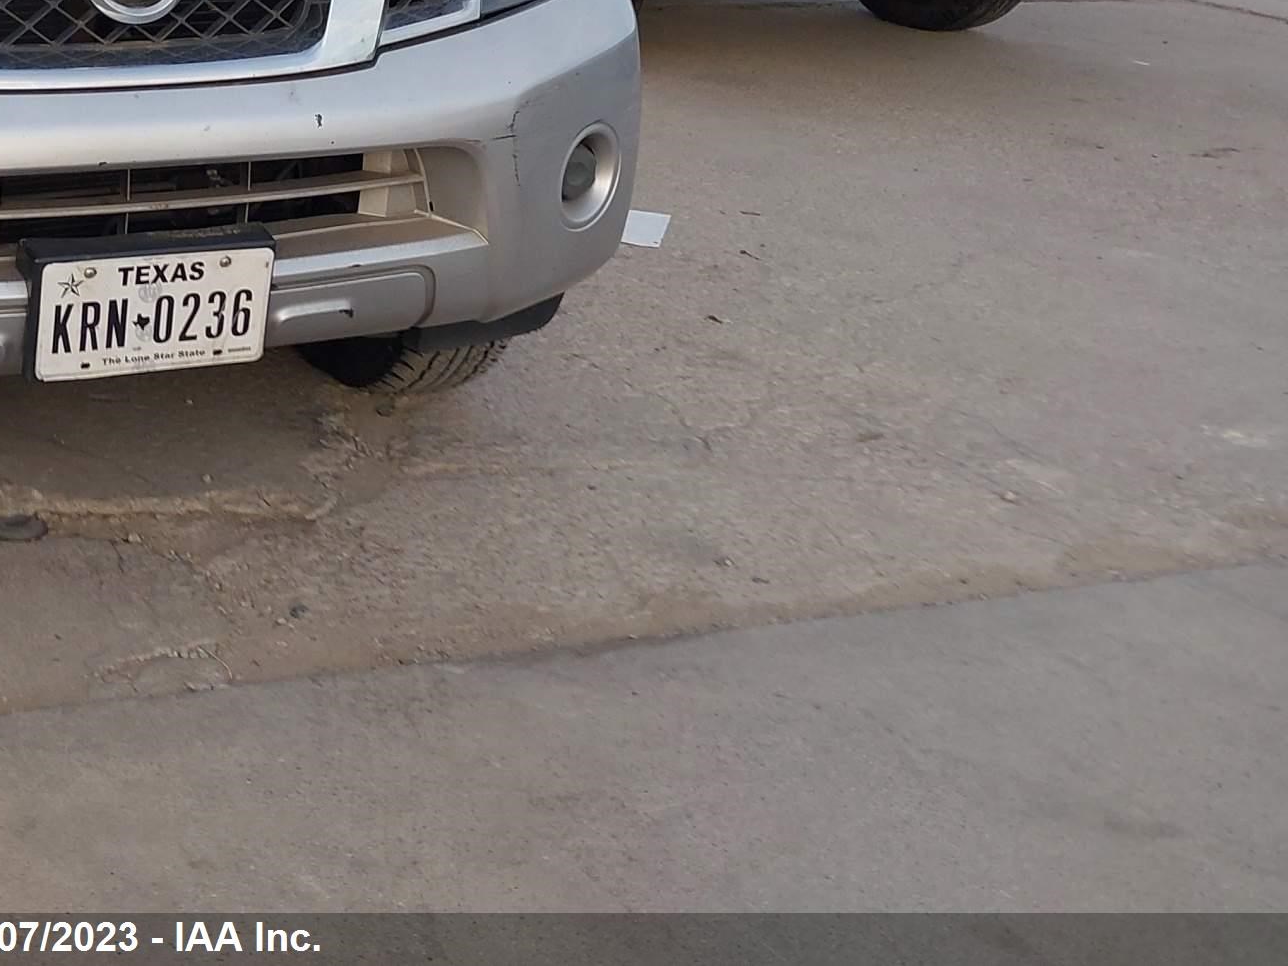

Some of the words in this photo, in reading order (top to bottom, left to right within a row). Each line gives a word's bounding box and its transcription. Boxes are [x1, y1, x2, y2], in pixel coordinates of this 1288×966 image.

[118, 261, 205, 286] TEXAS
[51, 297, 129, 354] KRN
[152, 288, 253, 343] 0236
[102, 356, 122, 366] The
[124, 353, 151, 364] Lone
[153, 350, 175, 361] Star
[178, 348, 206, 359] State
